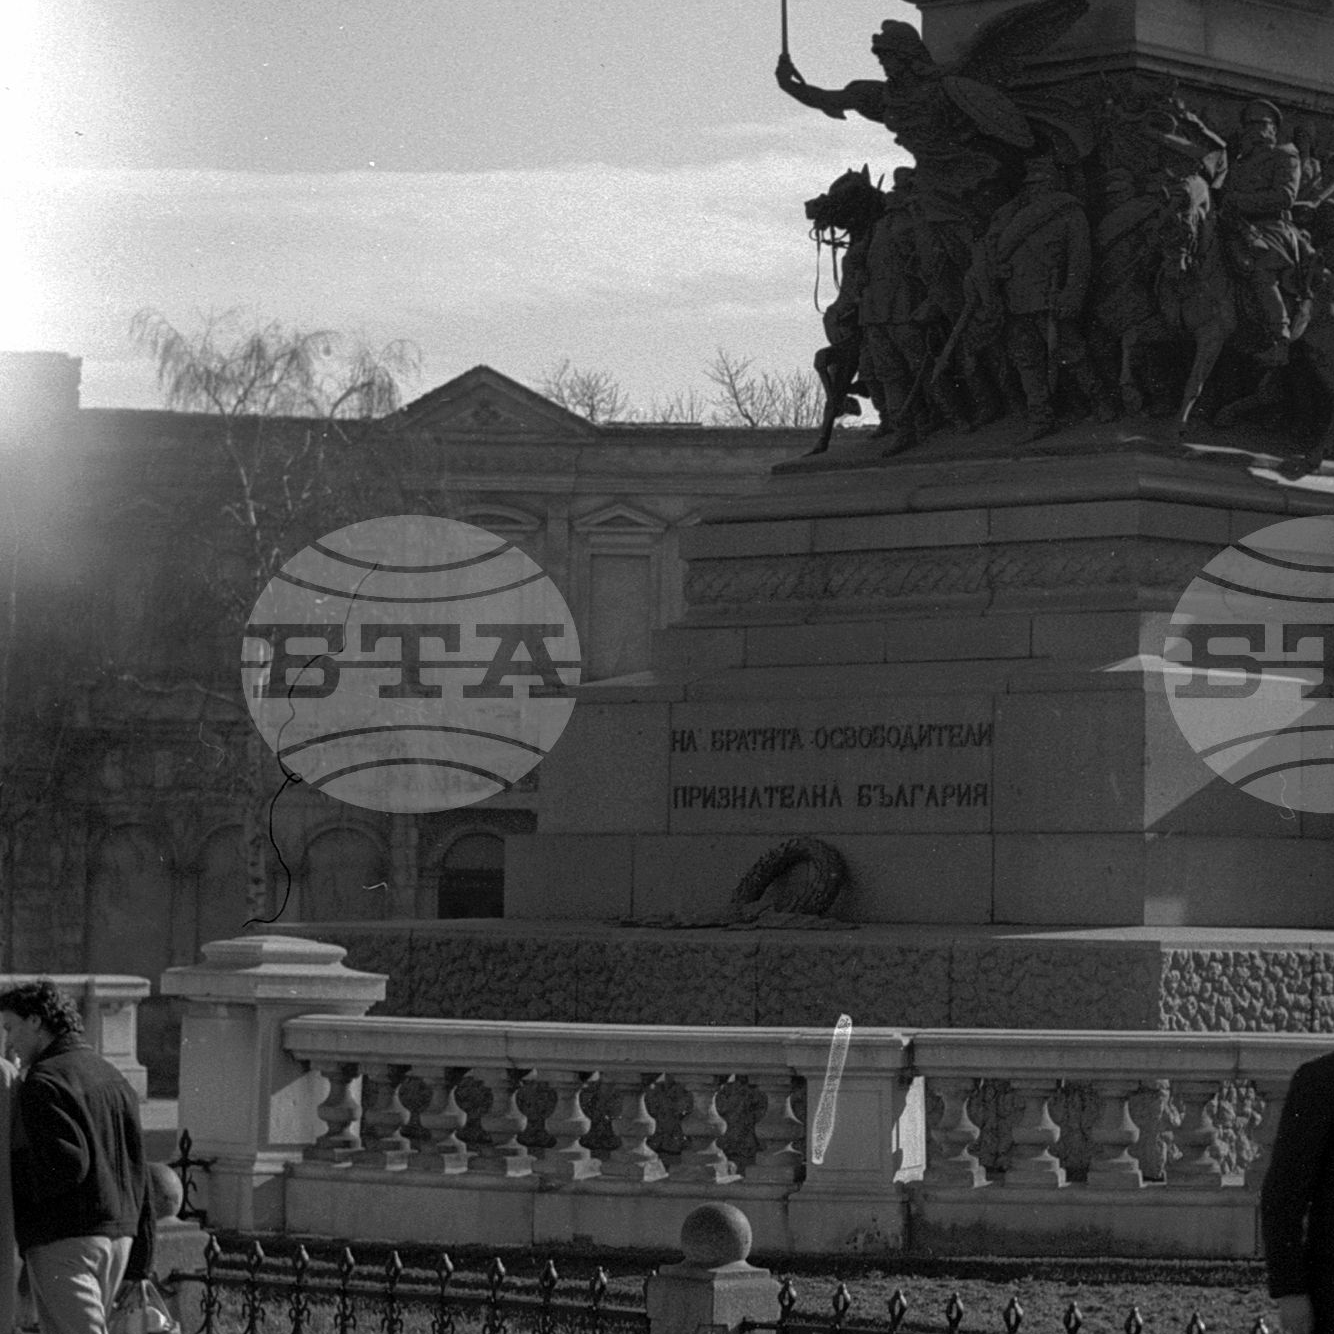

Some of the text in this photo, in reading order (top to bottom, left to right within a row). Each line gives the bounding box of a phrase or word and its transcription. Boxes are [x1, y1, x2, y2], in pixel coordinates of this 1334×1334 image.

[672, 728, 698, 752] НА
[814, 722, 993, 750] ОСВОБОДИТЕЛИ
[672, 783, 988, 809] ПРИЗНАТЕЛНА БЪЛГАРИЯ
